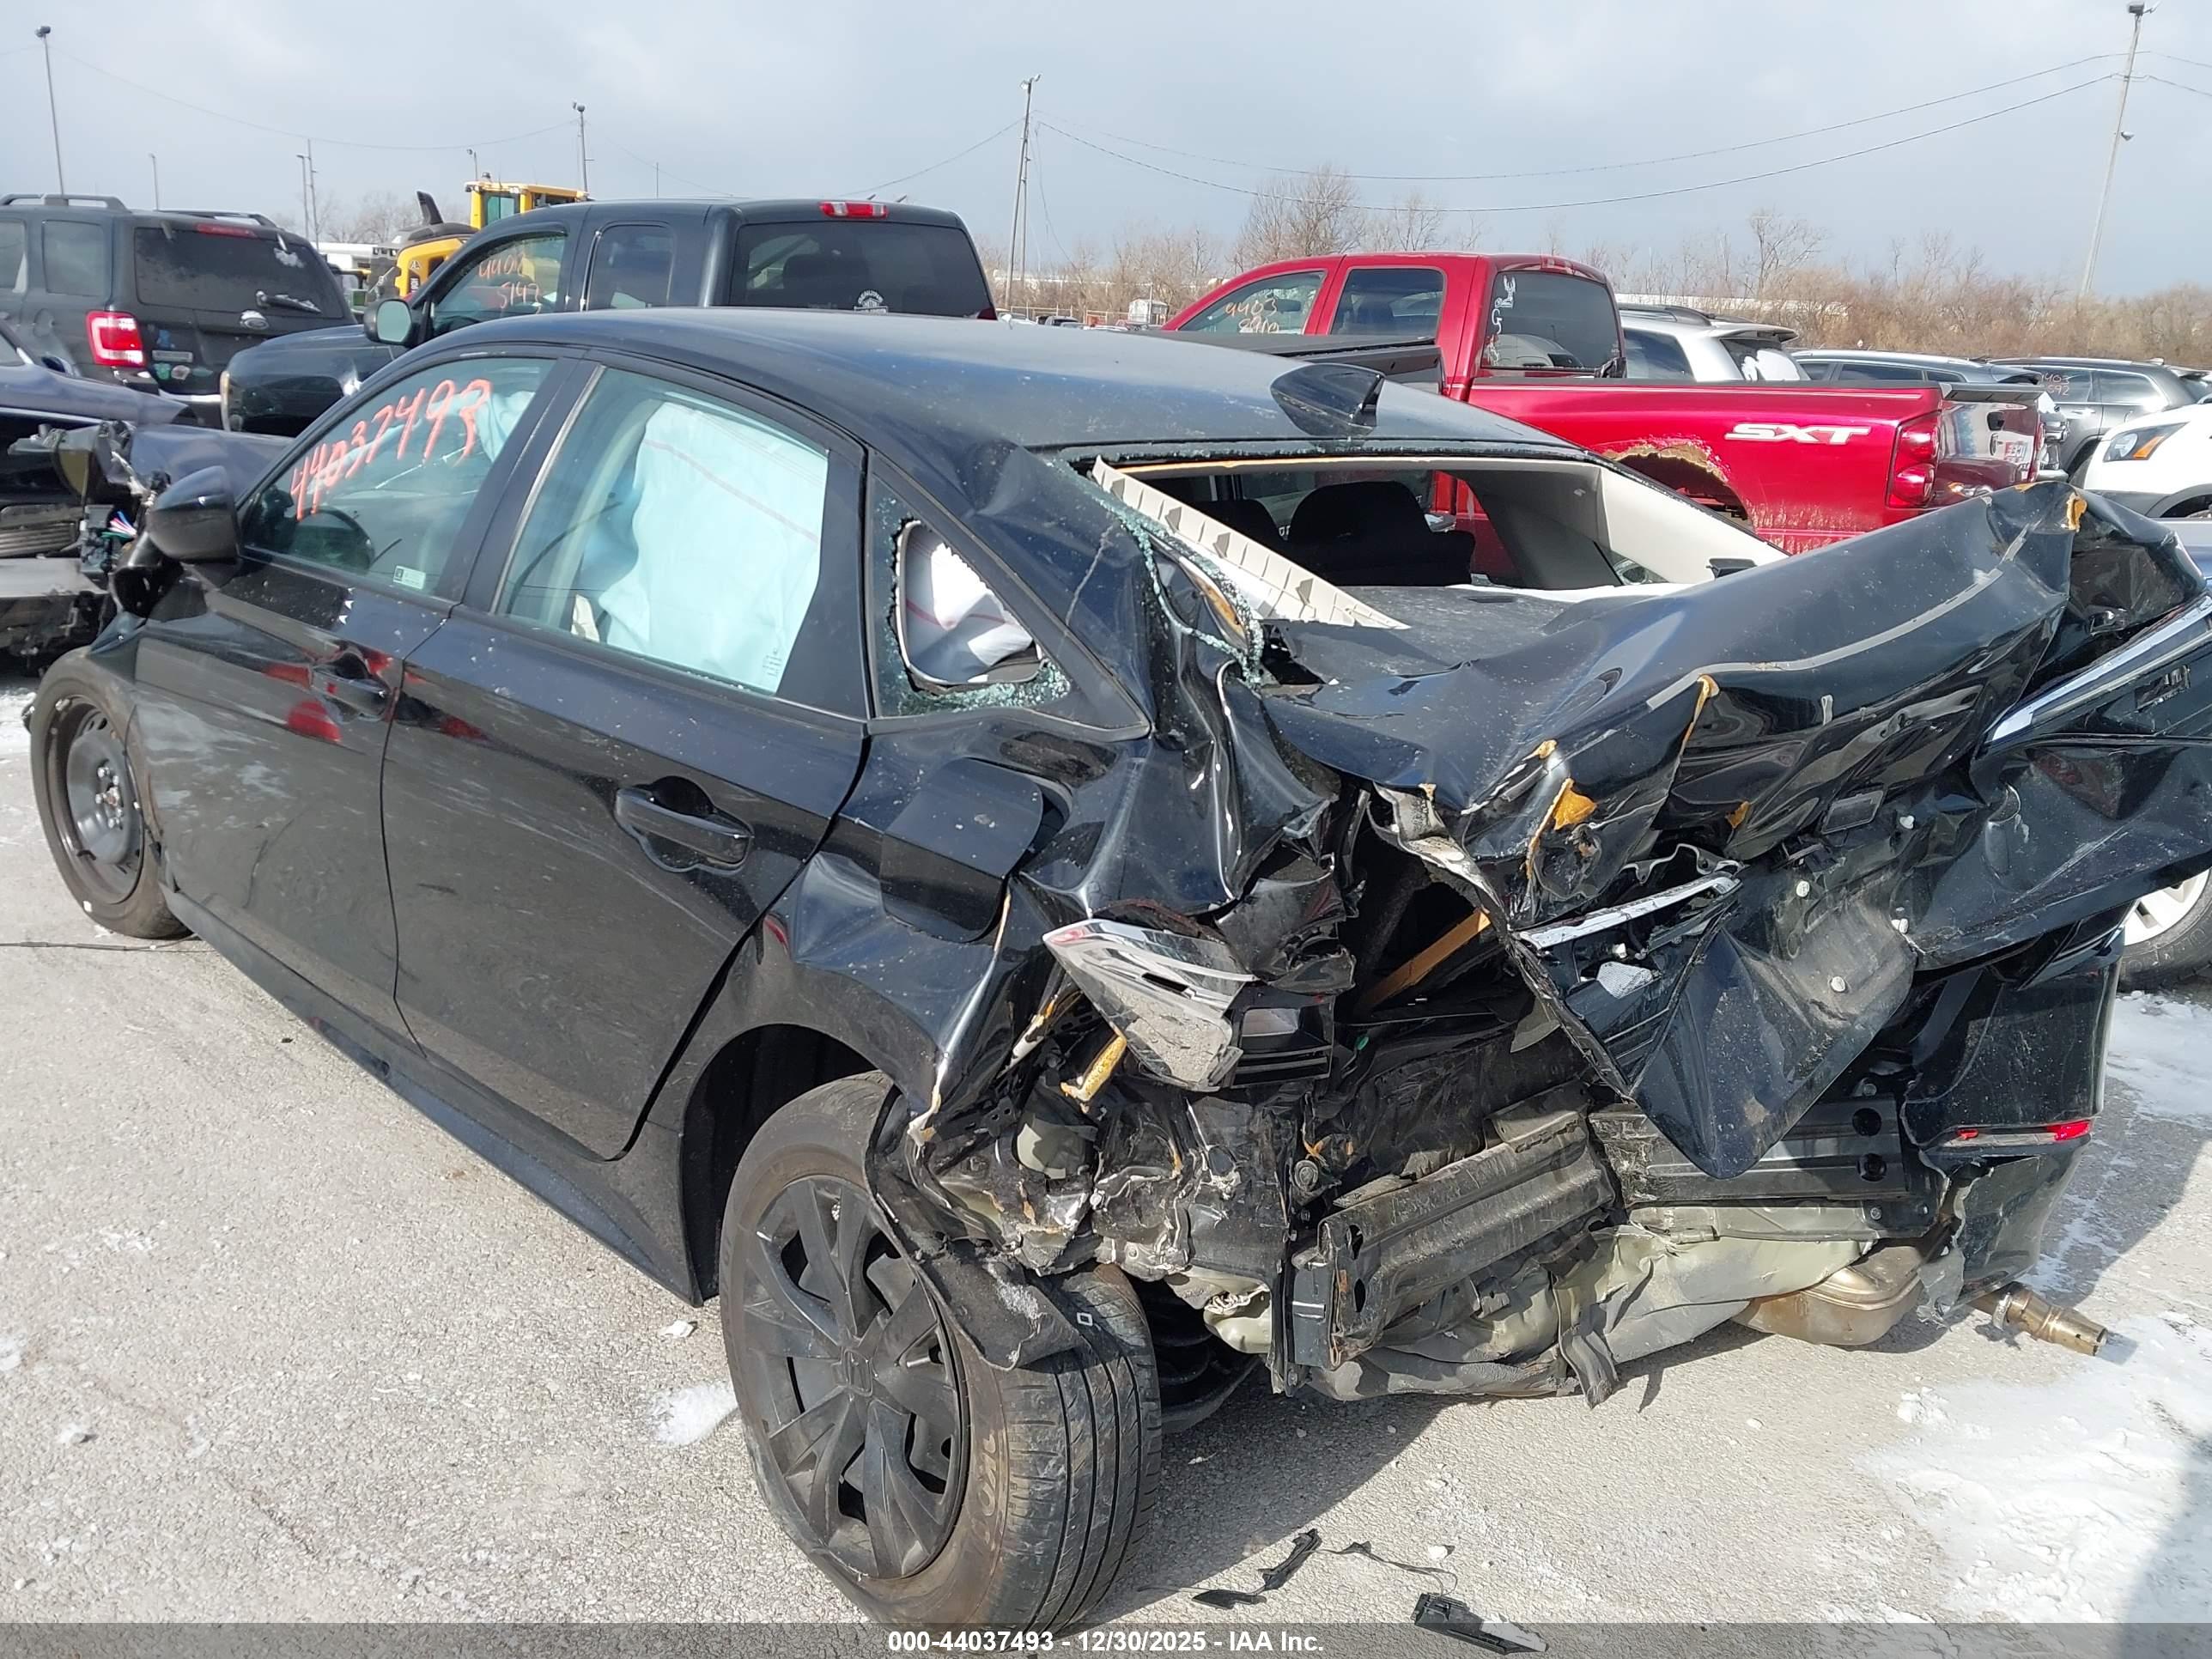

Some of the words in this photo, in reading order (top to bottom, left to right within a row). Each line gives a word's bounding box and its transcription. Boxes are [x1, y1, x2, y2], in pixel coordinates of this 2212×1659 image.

[1225, 297, 1278, 317] 4403
[1724, 423, 1872, 445] SXT
[290, 379, 493, 523] 44037493
